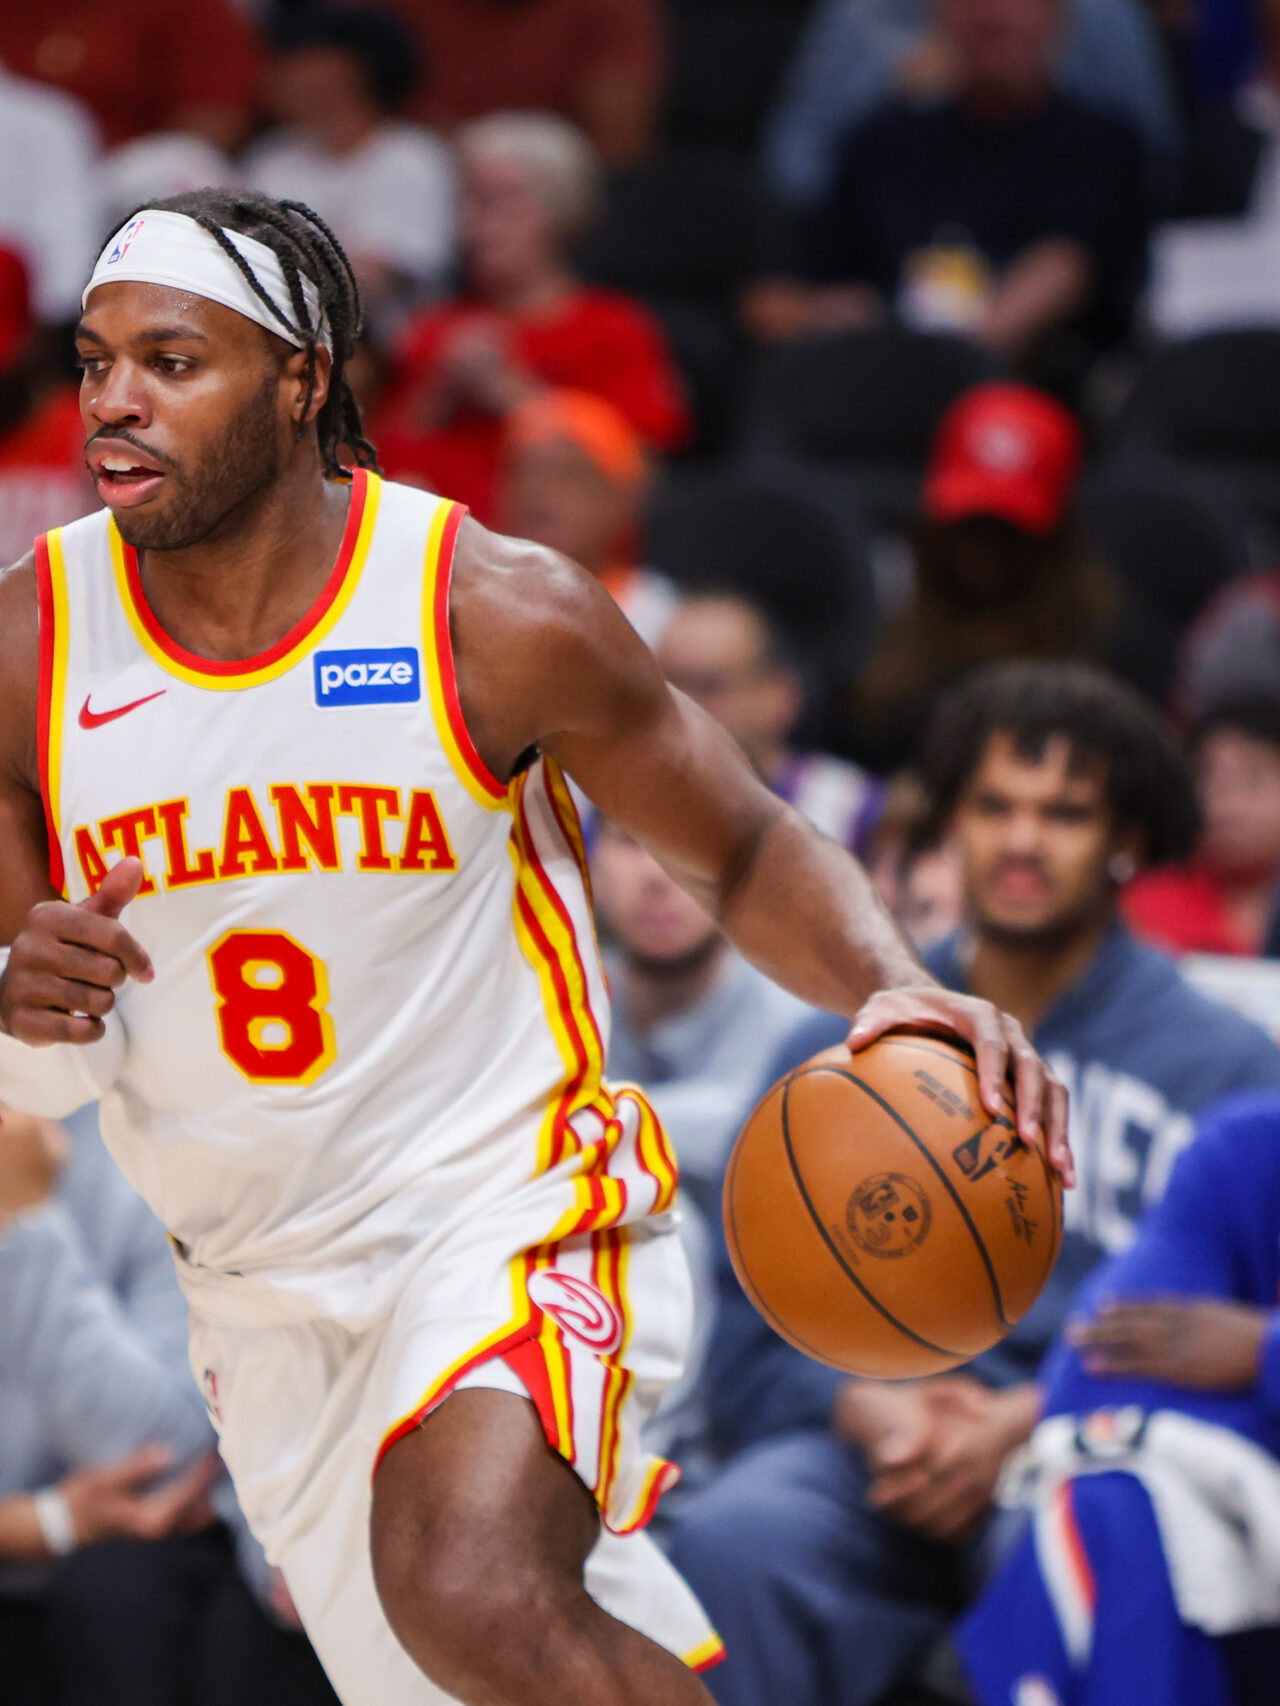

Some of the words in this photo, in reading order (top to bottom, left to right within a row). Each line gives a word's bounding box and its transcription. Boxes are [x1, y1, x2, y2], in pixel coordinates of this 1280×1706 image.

[320, 661, 413, 695] paze
[73, 782, 458, 898] ATLANTA
[205, 927, 337, 1086] 8
